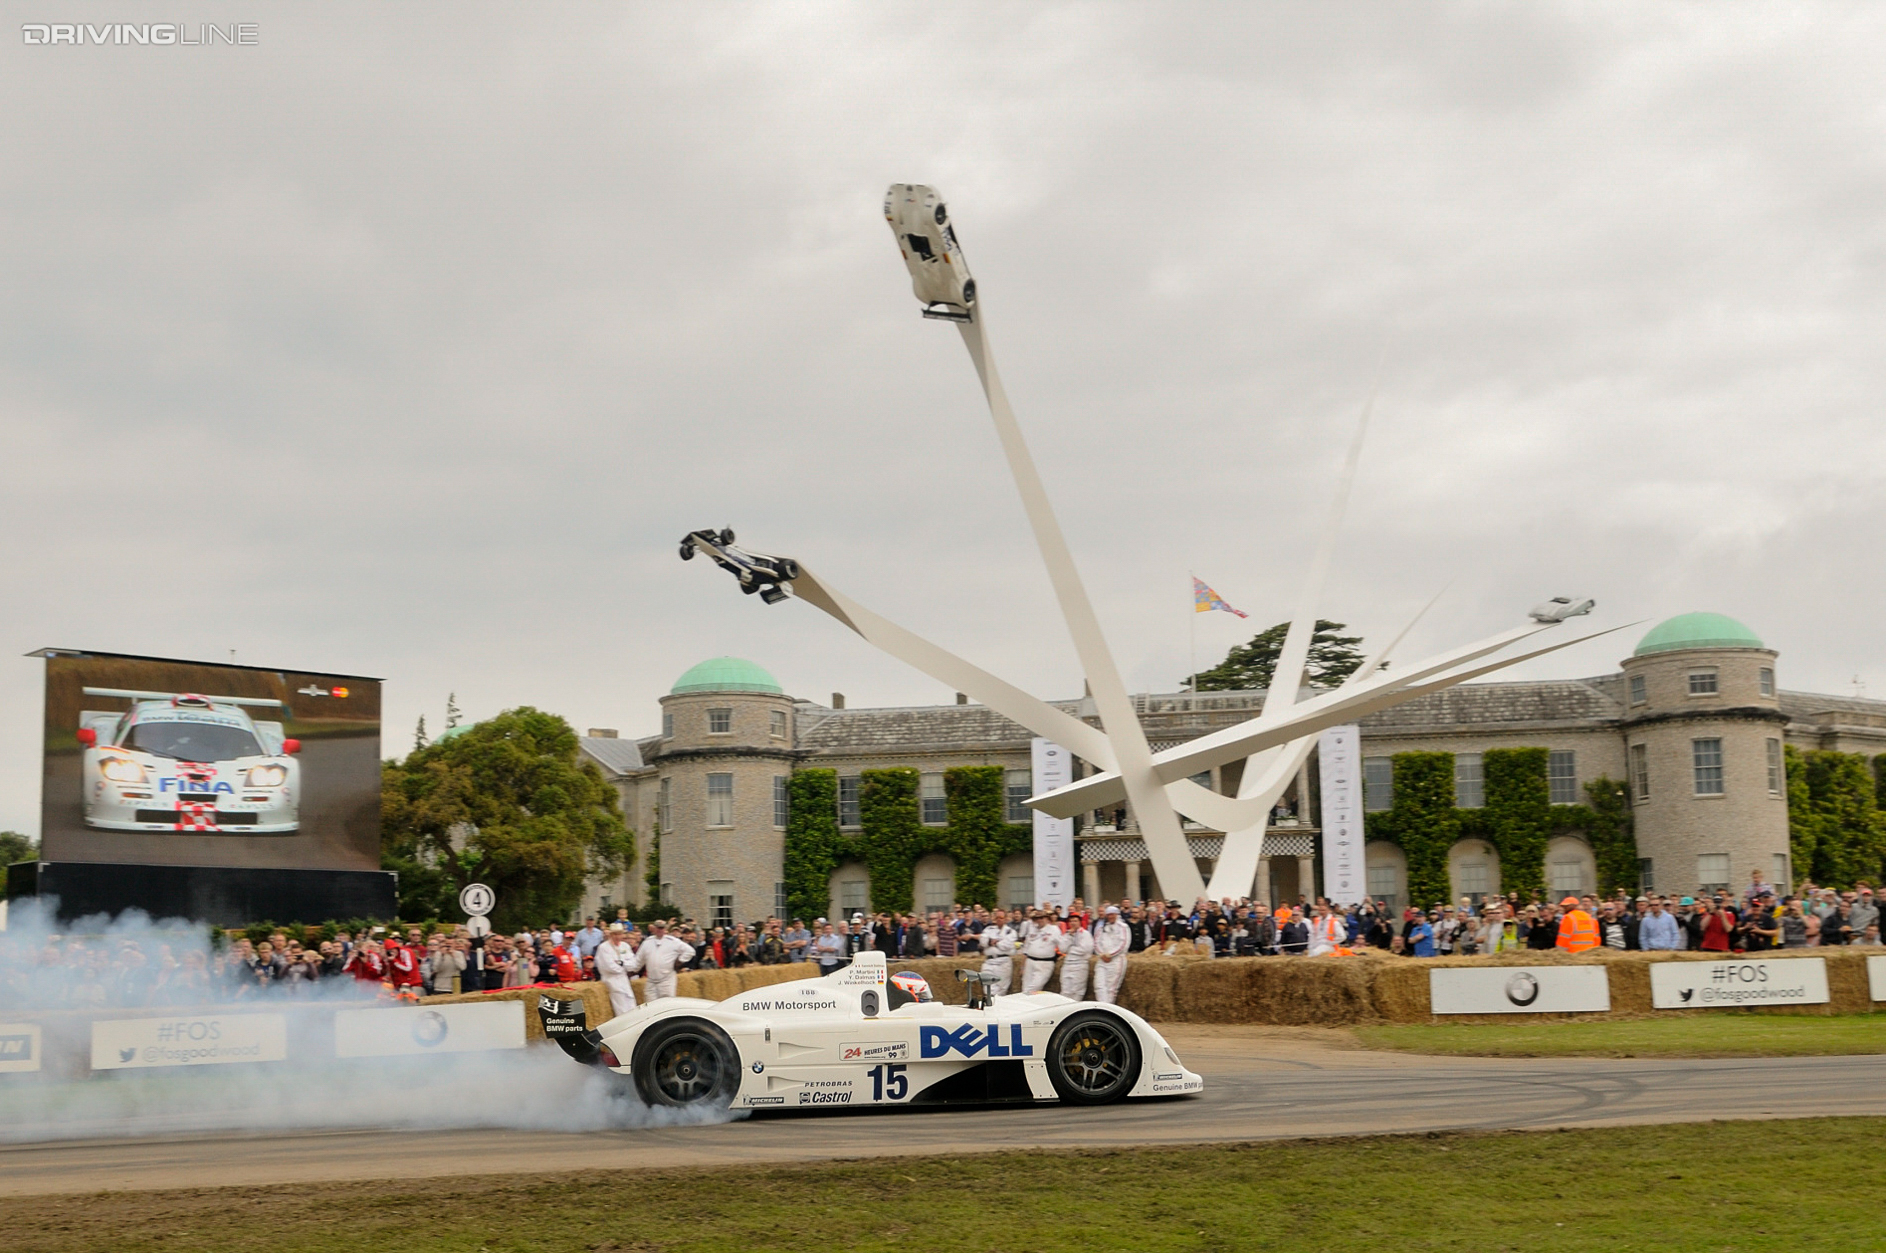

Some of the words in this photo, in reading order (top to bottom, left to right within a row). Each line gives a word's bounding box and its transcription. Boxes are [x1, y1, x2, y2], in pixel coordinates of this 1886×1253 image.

[159, 777, 235, 794] FINA
[472, 891, 482, 908] 4
[1711, 964, 1769, 983] #FOS
[1700, 985, 1806, 1003] @fosgoodwood
[742, 1002, 771, 1011] BMW
[774, 1000, 837, 1011] Motorsport
[157, 1021, 222, 1042] #FOS
[565, 1025, 583, 1033] parts
[919, 1022, 1034, 1059] DELL
[141, 1043, 261, 1063] @fosgoodwood
[843, 1046, 862, 1059] 24
[864, 1047, 883, 1055] HEURES
[892, 1043, 907, 1051] MANS
[888, 1051, 898, 1059] 99
[804, 1080, 853, 1088] PETROBRAS
[867, 1064, 909, 1101] 15
[1153, 1083, 1183, 1091] Genuine
[1184, 1081, 1198, 1090] BMW
[812, 1090, 853, 1103] Castrol
